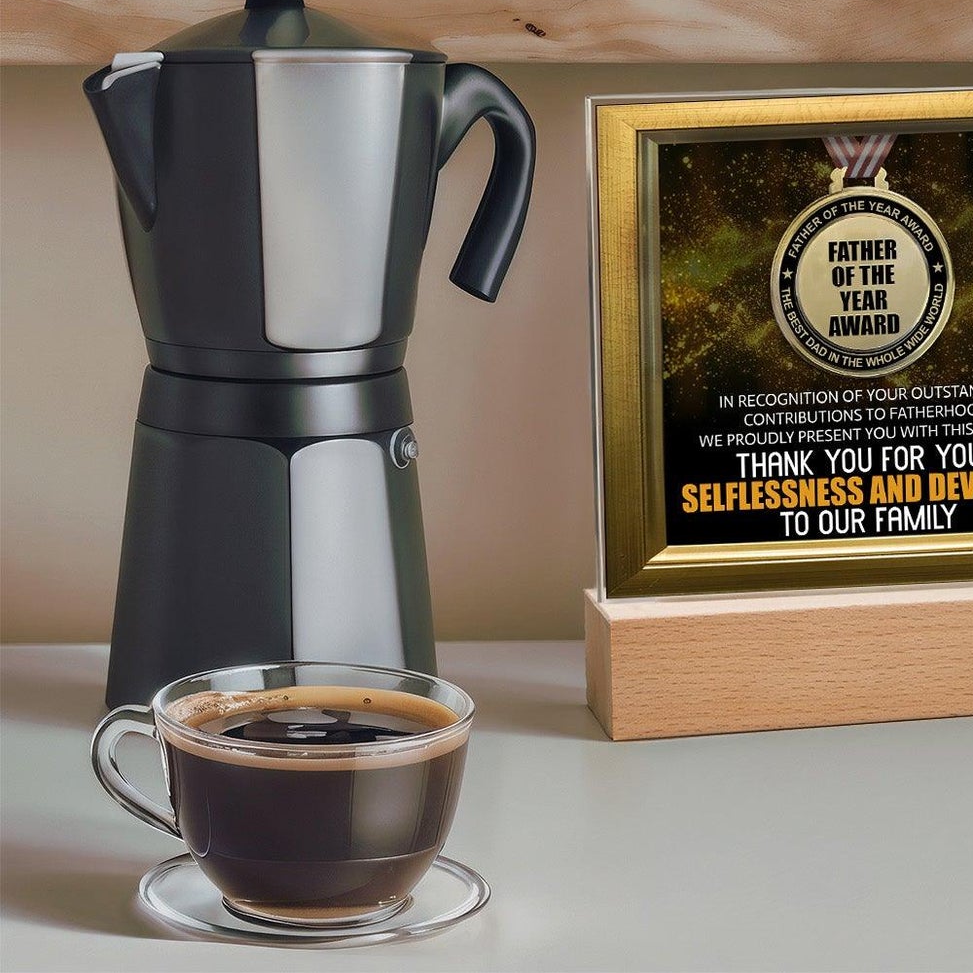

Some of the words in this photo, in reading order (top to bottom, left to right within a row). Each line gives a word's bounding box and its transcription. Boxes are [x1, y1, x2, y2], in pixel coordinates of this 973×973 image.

[788, 216, 822, 259] FATHER
[823, 205, 839, 221] OF
[841, 200, 865, 213] THE
[868, 201, 901, 220] YEAR
[900, 215, 934, 253] AWARD
[828, 239, 897, 262] FATHER
[831, 265, 855, 287] OF
[859, 264, 895, 286] THE
[840, 289, 888, 311] YEAR
[781, 286, 793, 310] THE
[788, 310, 809, 339] BEST
[805, 336, 828, 357] DAD
[828, 352, 839, 364] IN
[842, 355, 863, 367] THE
[865, 347, 906, 367] WHOLE
[904, 325, 930, 351] WIDE
[924, 283, 944, 325] WORLD
[828, 313, 900, 337] AWARD
[719, 395, 734, 409] IN
[738, 390, 839, 408] RECOGNITION
[842, 389, 863, 403] OF
[866, 387, 908, 402] YOUR
[743, 408, 863, 427] CONTRIBUTIONS
[865, 407, 886, 421] TO
[698, 434, 723, 448] WE
[727, 430, 795, 446] PROUDLY
[798, 427, 862, 443] PRESENT
[864, 426, 896, 440] YOU
[899, 424, 938, 439] WITH
[941, 422, 973, 437] THIS
[735, 450, 814, 479] THANK
[824, 447, 873, 475] YOU
[881, 444, 925, 472] FOR
[681, 475, 864, 514] SELFLESSNESS
[869, 473, 922, 505] AND
[779, 510, 810, 537] TO
[818, 507, 866, 535] OUR
[875, 503, 958, 533] FAMILY
